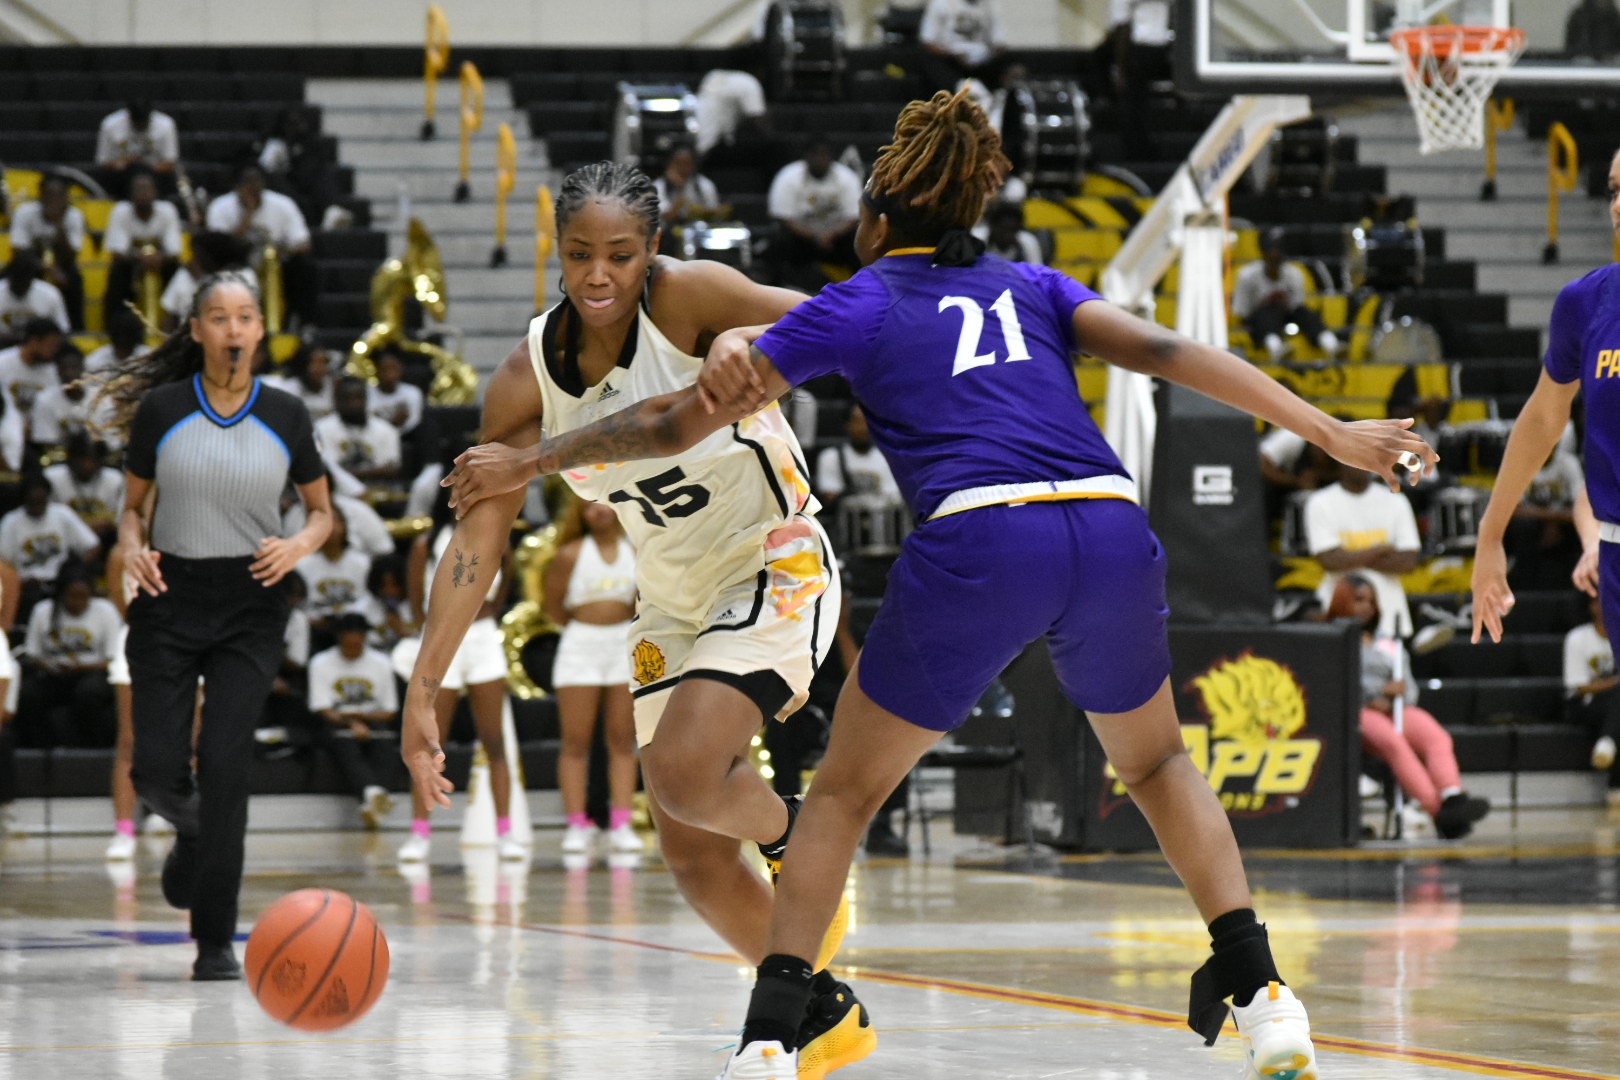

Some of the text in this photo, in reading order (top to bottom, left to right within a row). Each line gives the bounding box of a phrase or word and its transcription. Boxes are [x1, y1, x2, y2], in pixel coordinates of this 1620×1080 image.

[938, 288, 1033, 378] 21
[608, 465, 711, 528] 15
[1104, 724, 1322, 793] PB
